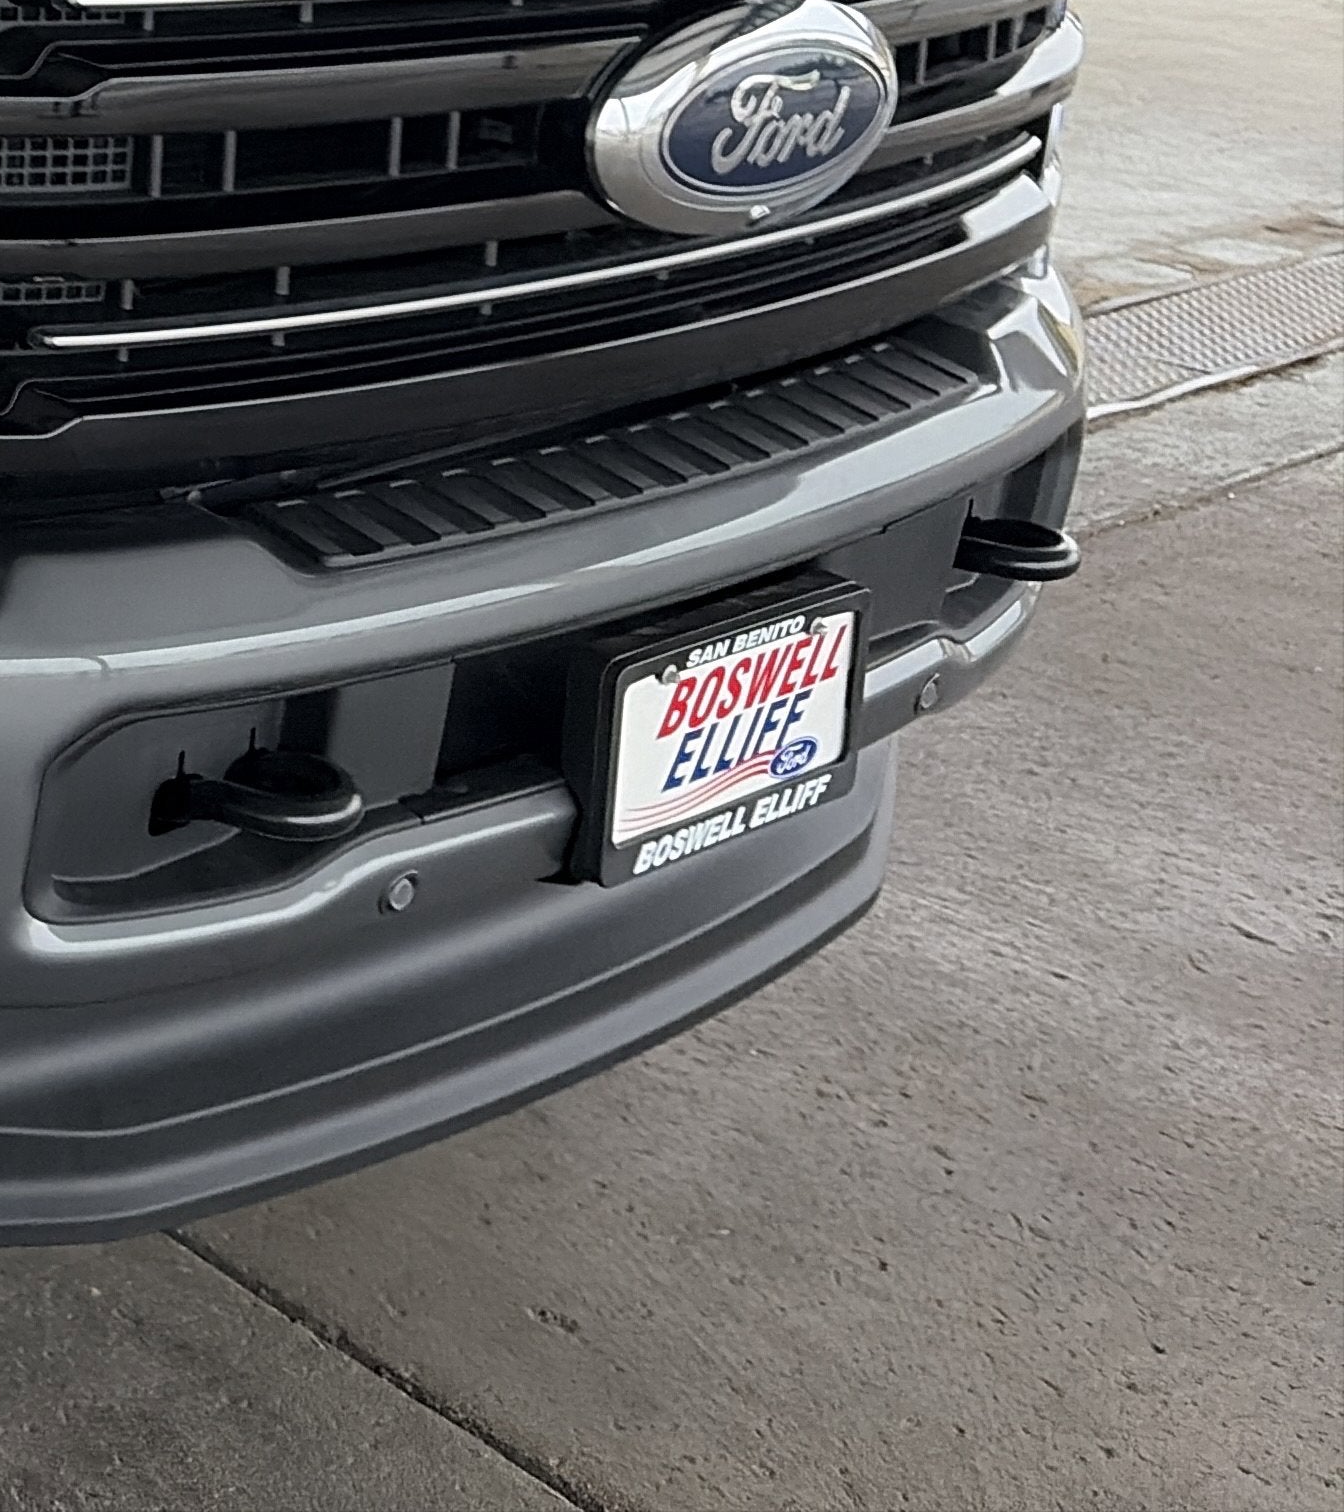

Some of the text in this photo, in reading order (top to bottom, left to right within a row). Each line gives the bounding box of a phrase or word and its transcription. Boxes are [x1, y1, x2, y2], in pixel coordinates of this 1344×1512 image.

[711, 68, 852, 176] Ford
[656, 624, 848, 739] BOSWELL
[685, 615, 807, 668] SAN BENITO
[662, 689, 813, 793] ELLIFF
[632, 773, 832, 875] BOSWELL ELLIFF
